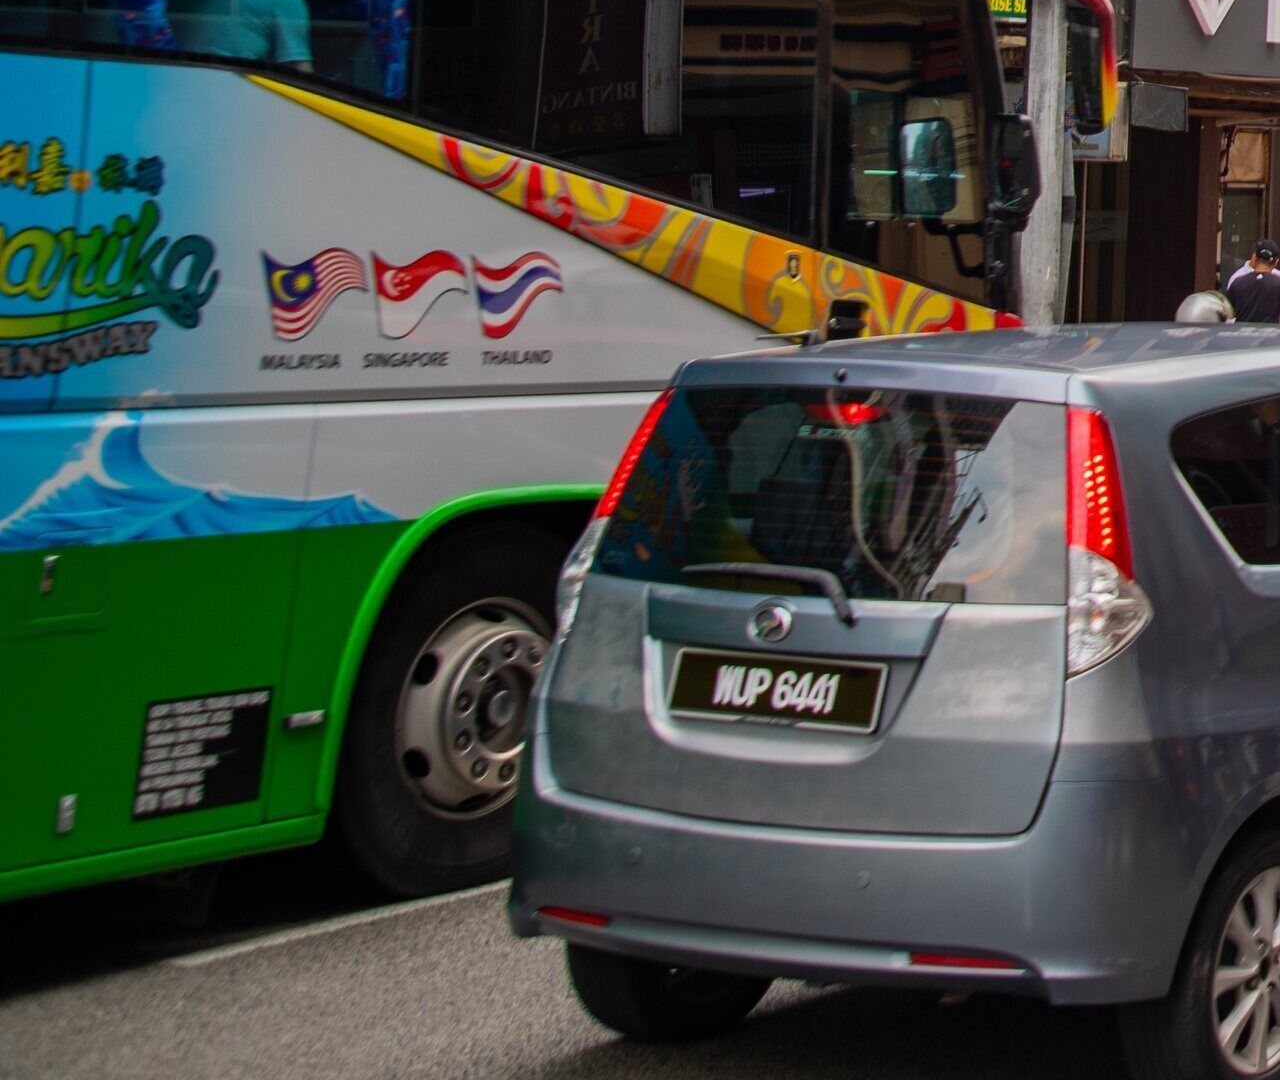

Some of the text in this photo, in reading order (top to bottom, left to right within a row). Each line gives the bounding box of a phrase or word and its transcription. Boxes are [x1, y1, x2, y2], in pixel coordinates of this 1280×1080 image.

[258, 349, 553, 371] MALAYSIA SINGAPORE THAILAND
[712, 664, 842, 714] WUP 6441
